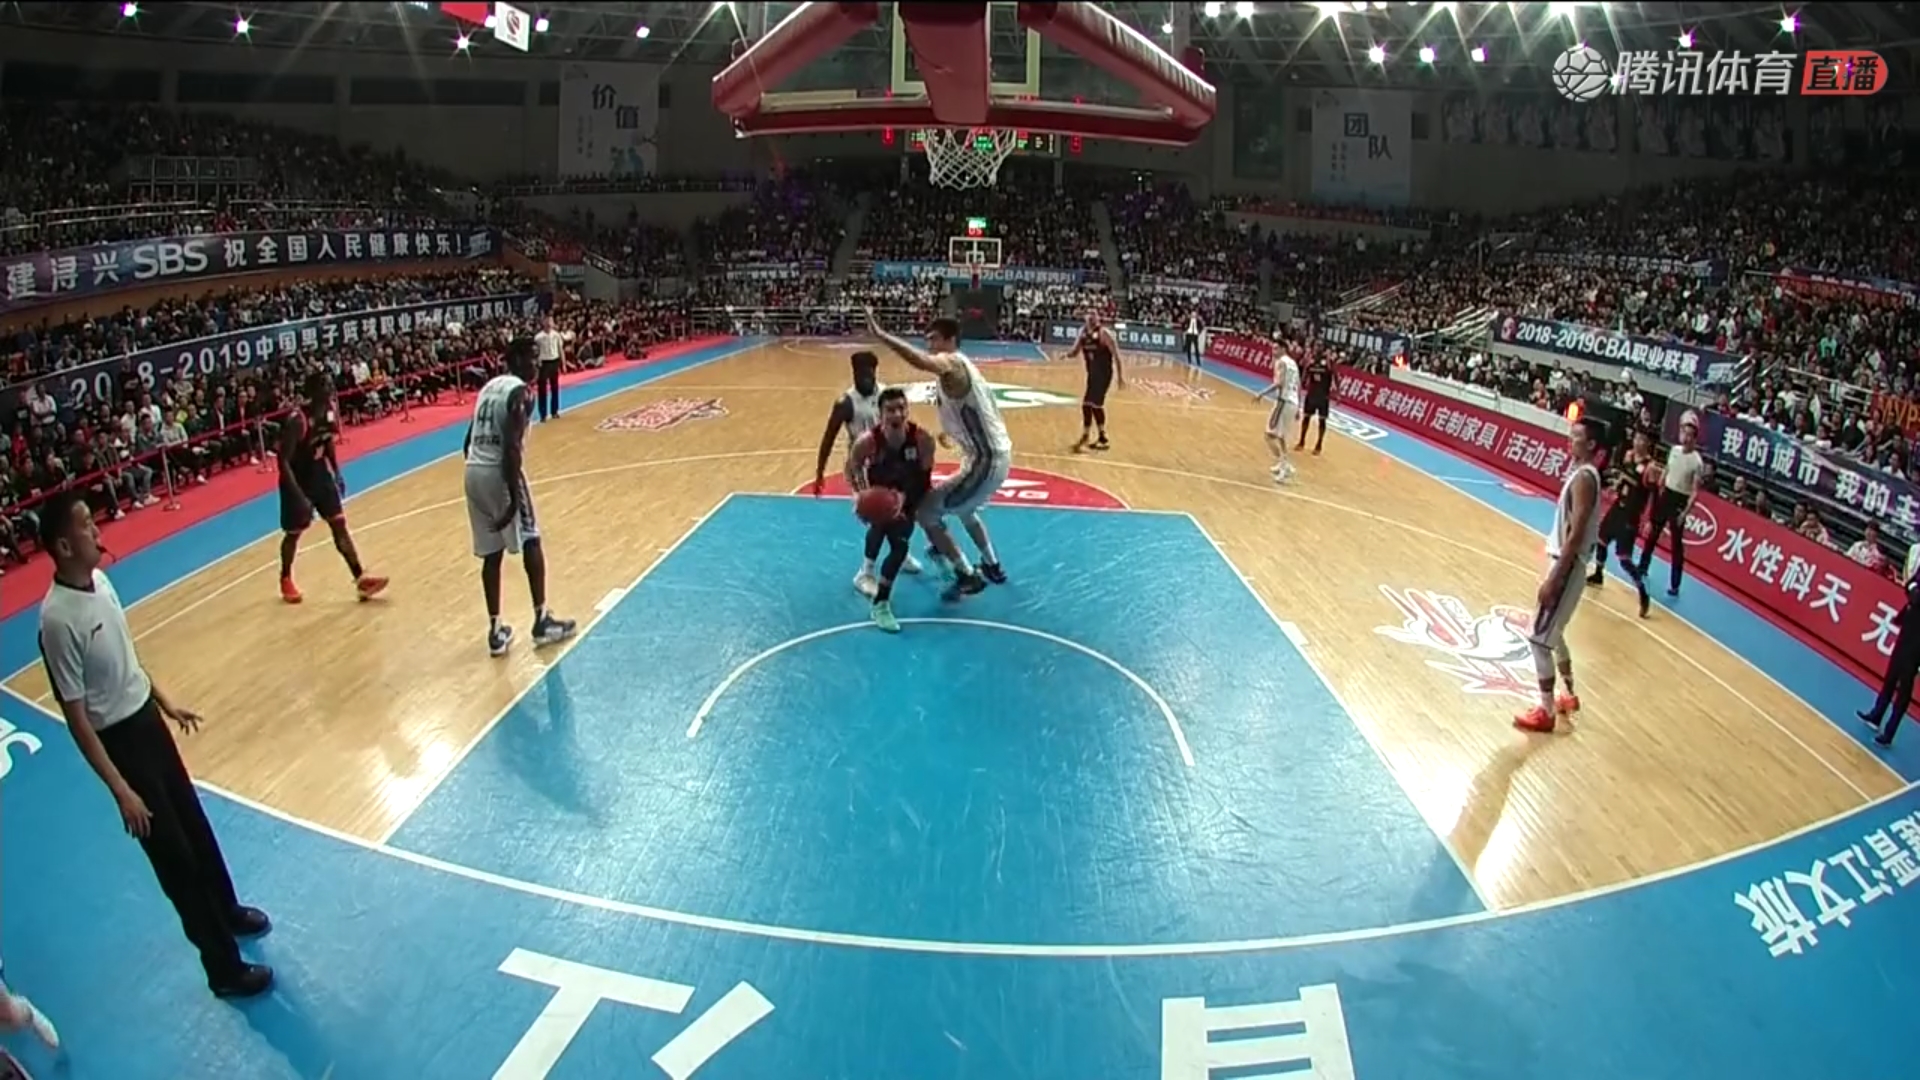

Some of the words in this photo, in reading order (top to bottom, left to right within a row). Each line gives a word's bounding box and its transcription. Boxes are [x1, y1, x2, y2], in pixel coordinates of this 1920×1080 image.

[591, 84, 640, 129] 价值
[1343, 112, 1393, 160] 团队
[1515, 322, 1700, 378] 2018-2019CBA职业联赛
[1375, 387, 1430, 422] 家装材料
[1430, 406, 1499, 450] 定制家具
[1721, 427, 1821, 486] 我的城市
[1717, 527, 1852, 624] 水性科天
